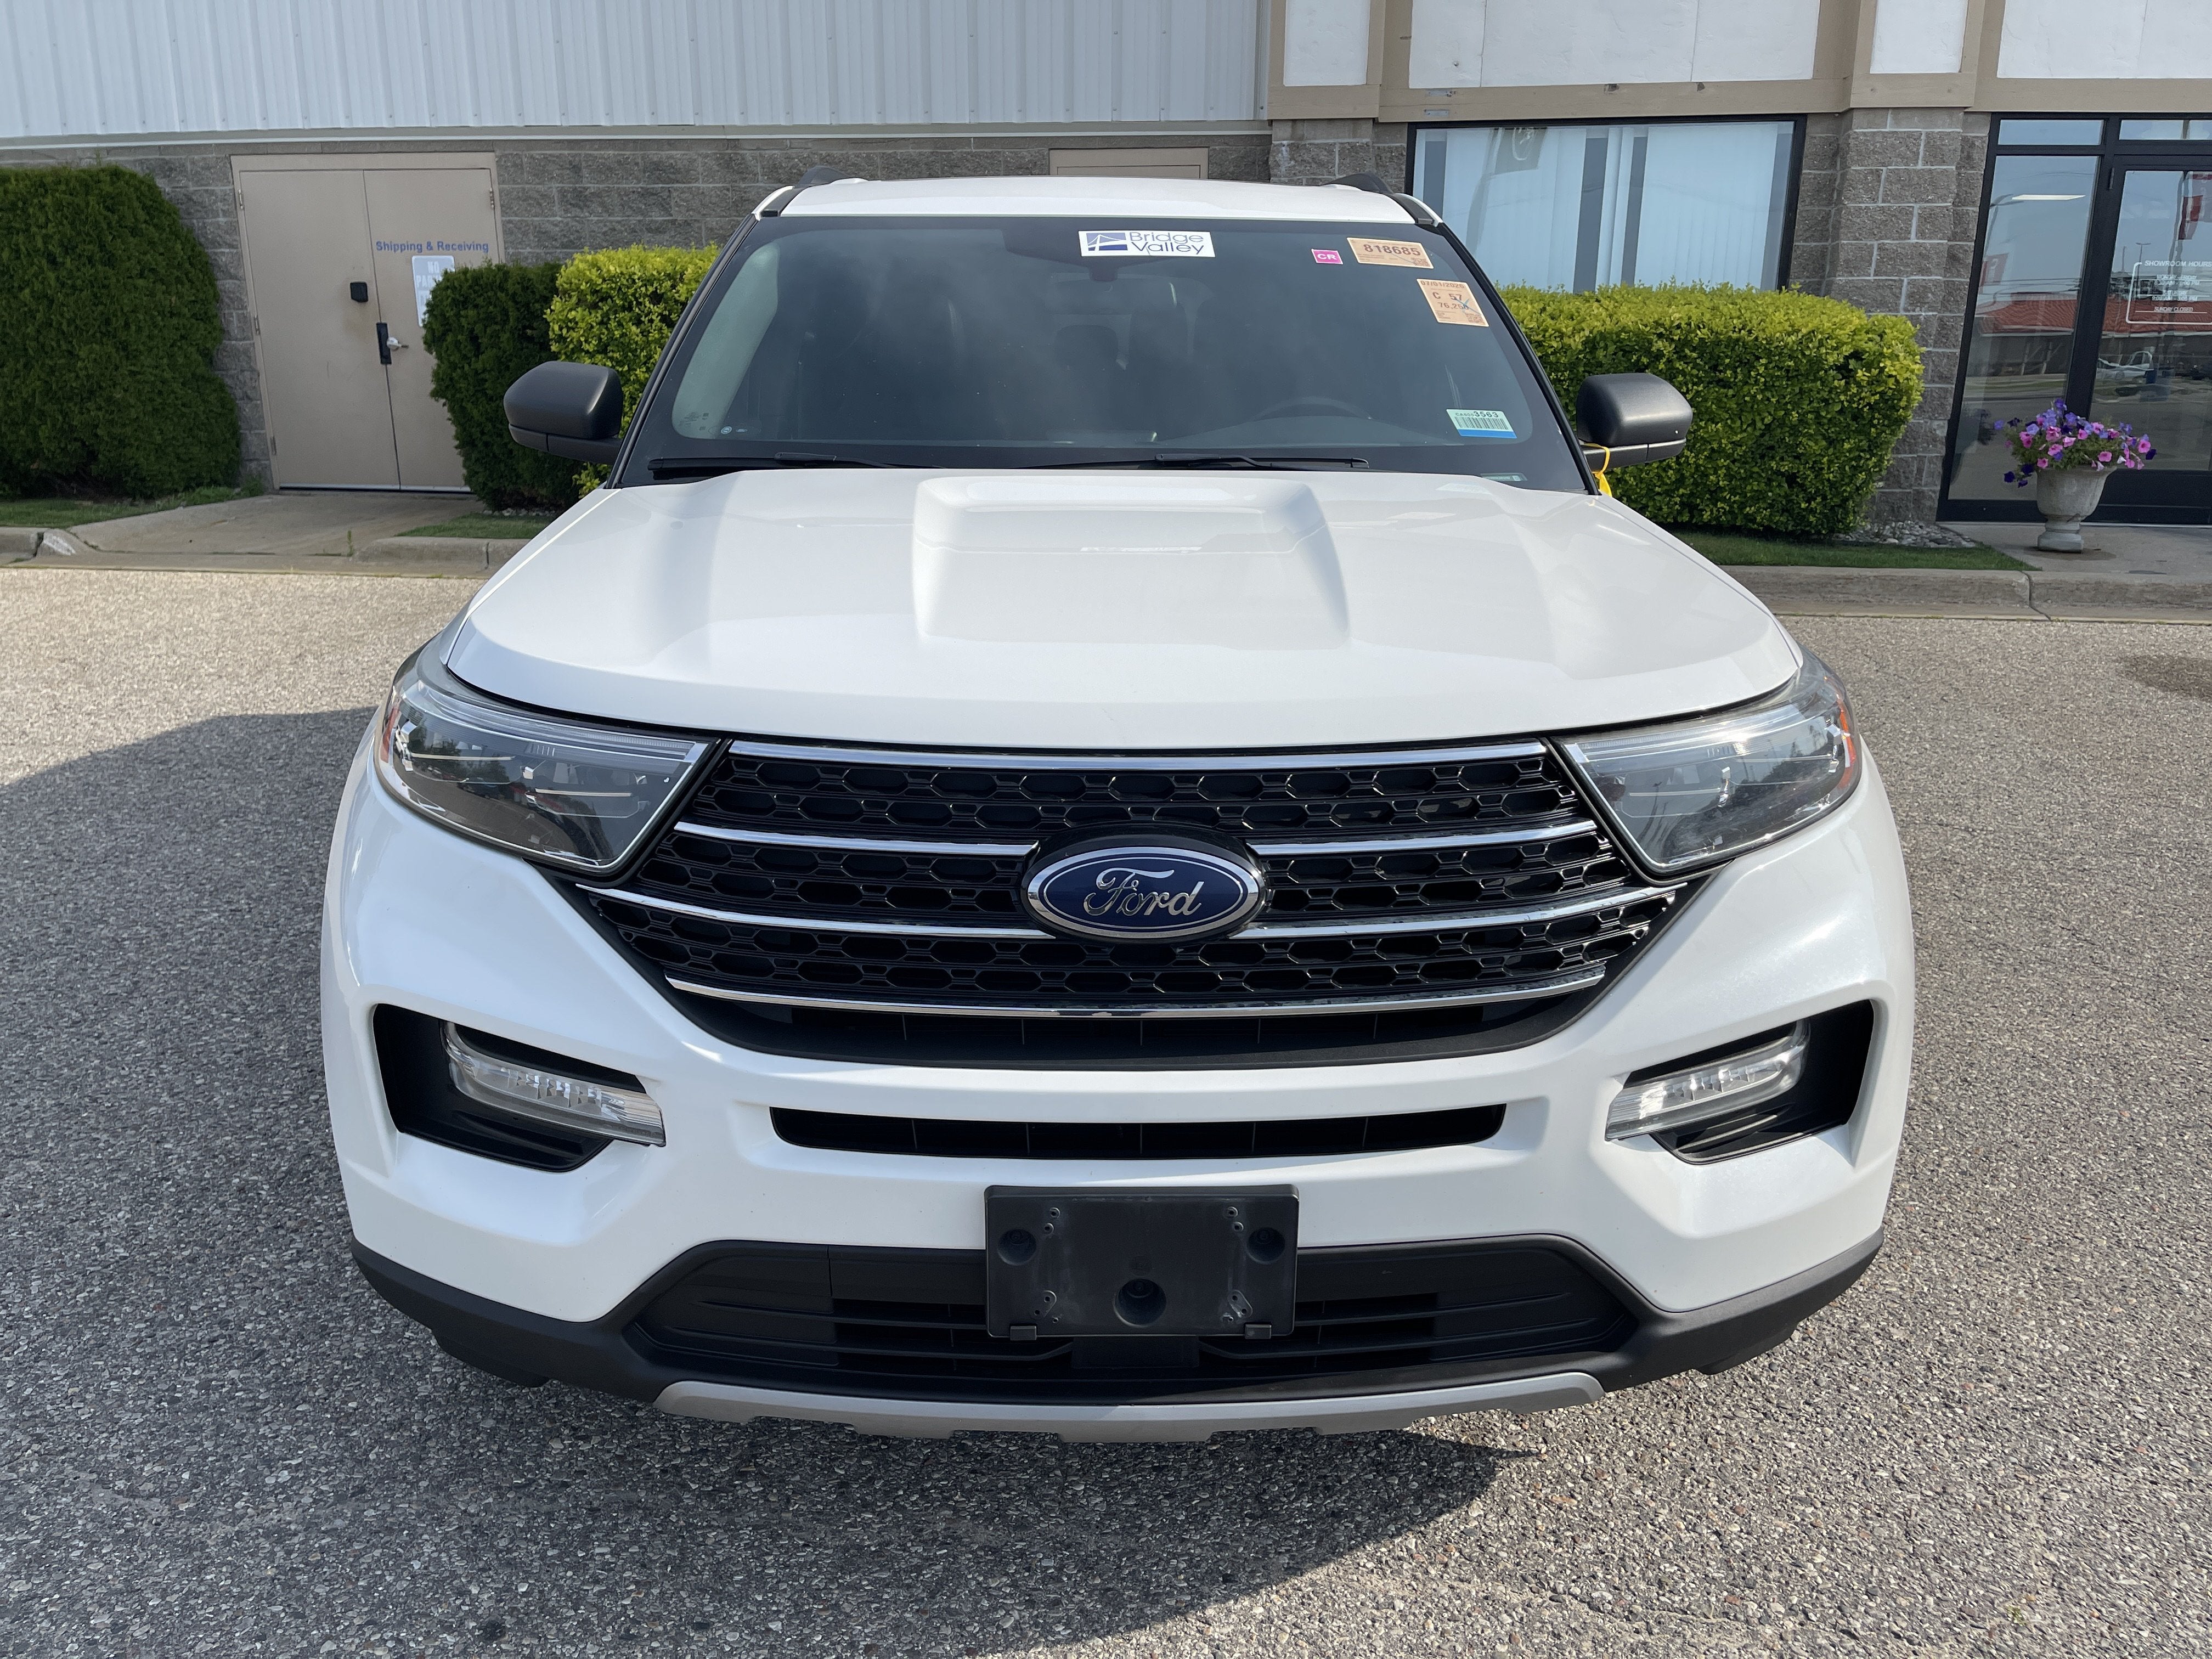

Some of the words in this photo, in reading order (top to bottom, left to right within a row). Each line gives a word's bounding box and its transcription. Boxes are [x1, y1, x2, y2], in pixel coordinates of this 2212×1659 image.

[1129, 232, 1204, 244] Bridge
[376, 240, 423, 253] Shipping
[426, 241, 433, 251] &
[437, 240, 489, 253] Receiving
[1131, 241, 1204, 255] Valley
[1363, 244, 1421, 256] 818685
[427, 261, 439, 273] NO
[1083, 867, 1204, 917] Ford
